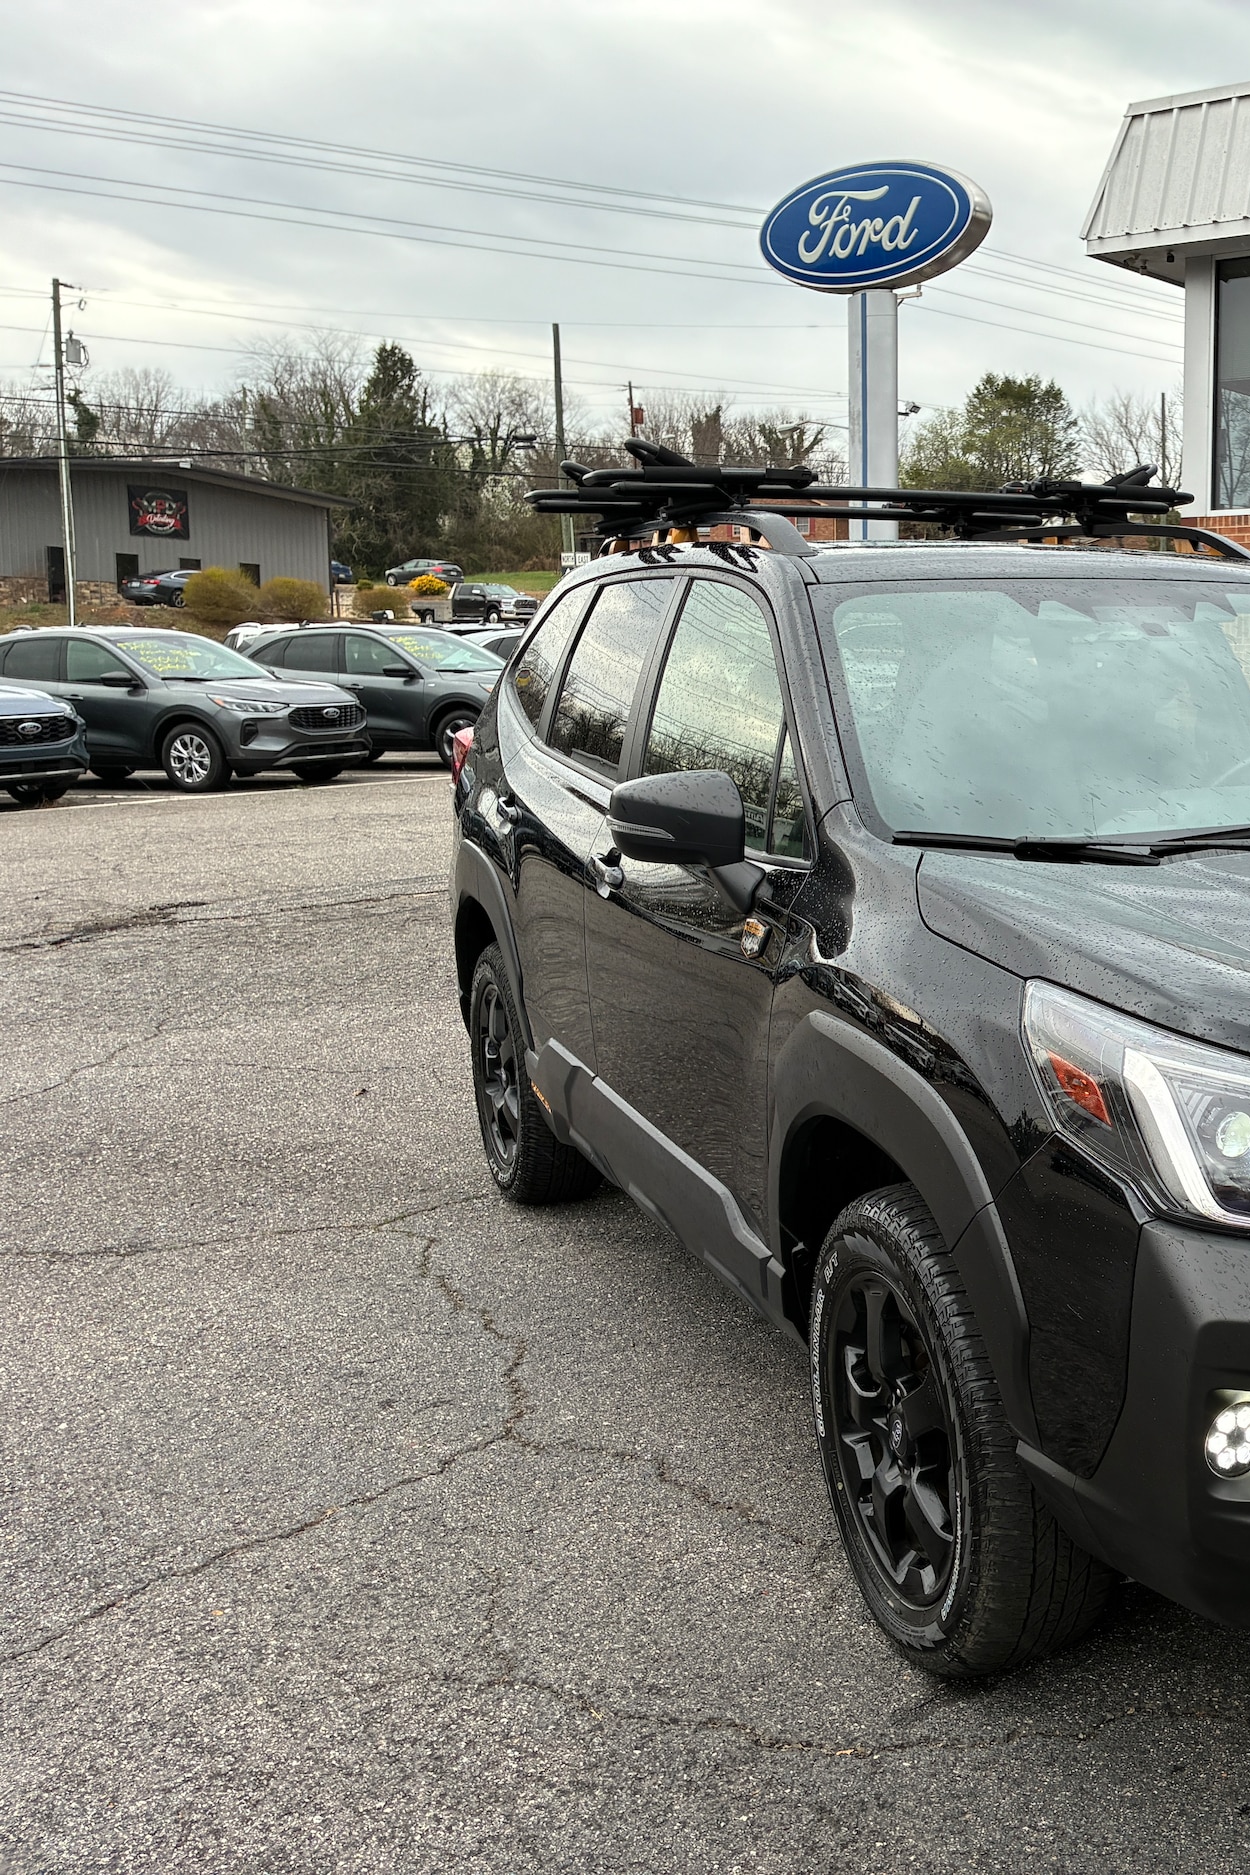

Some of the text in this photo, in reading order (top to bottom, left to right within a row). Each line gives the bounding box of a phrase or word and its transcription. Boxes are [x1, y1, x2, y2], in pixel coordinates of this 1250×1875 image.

[798, 185, 922, 264] Ford
[812, 1251, 838, 1437] GEOLANDAR A/T
